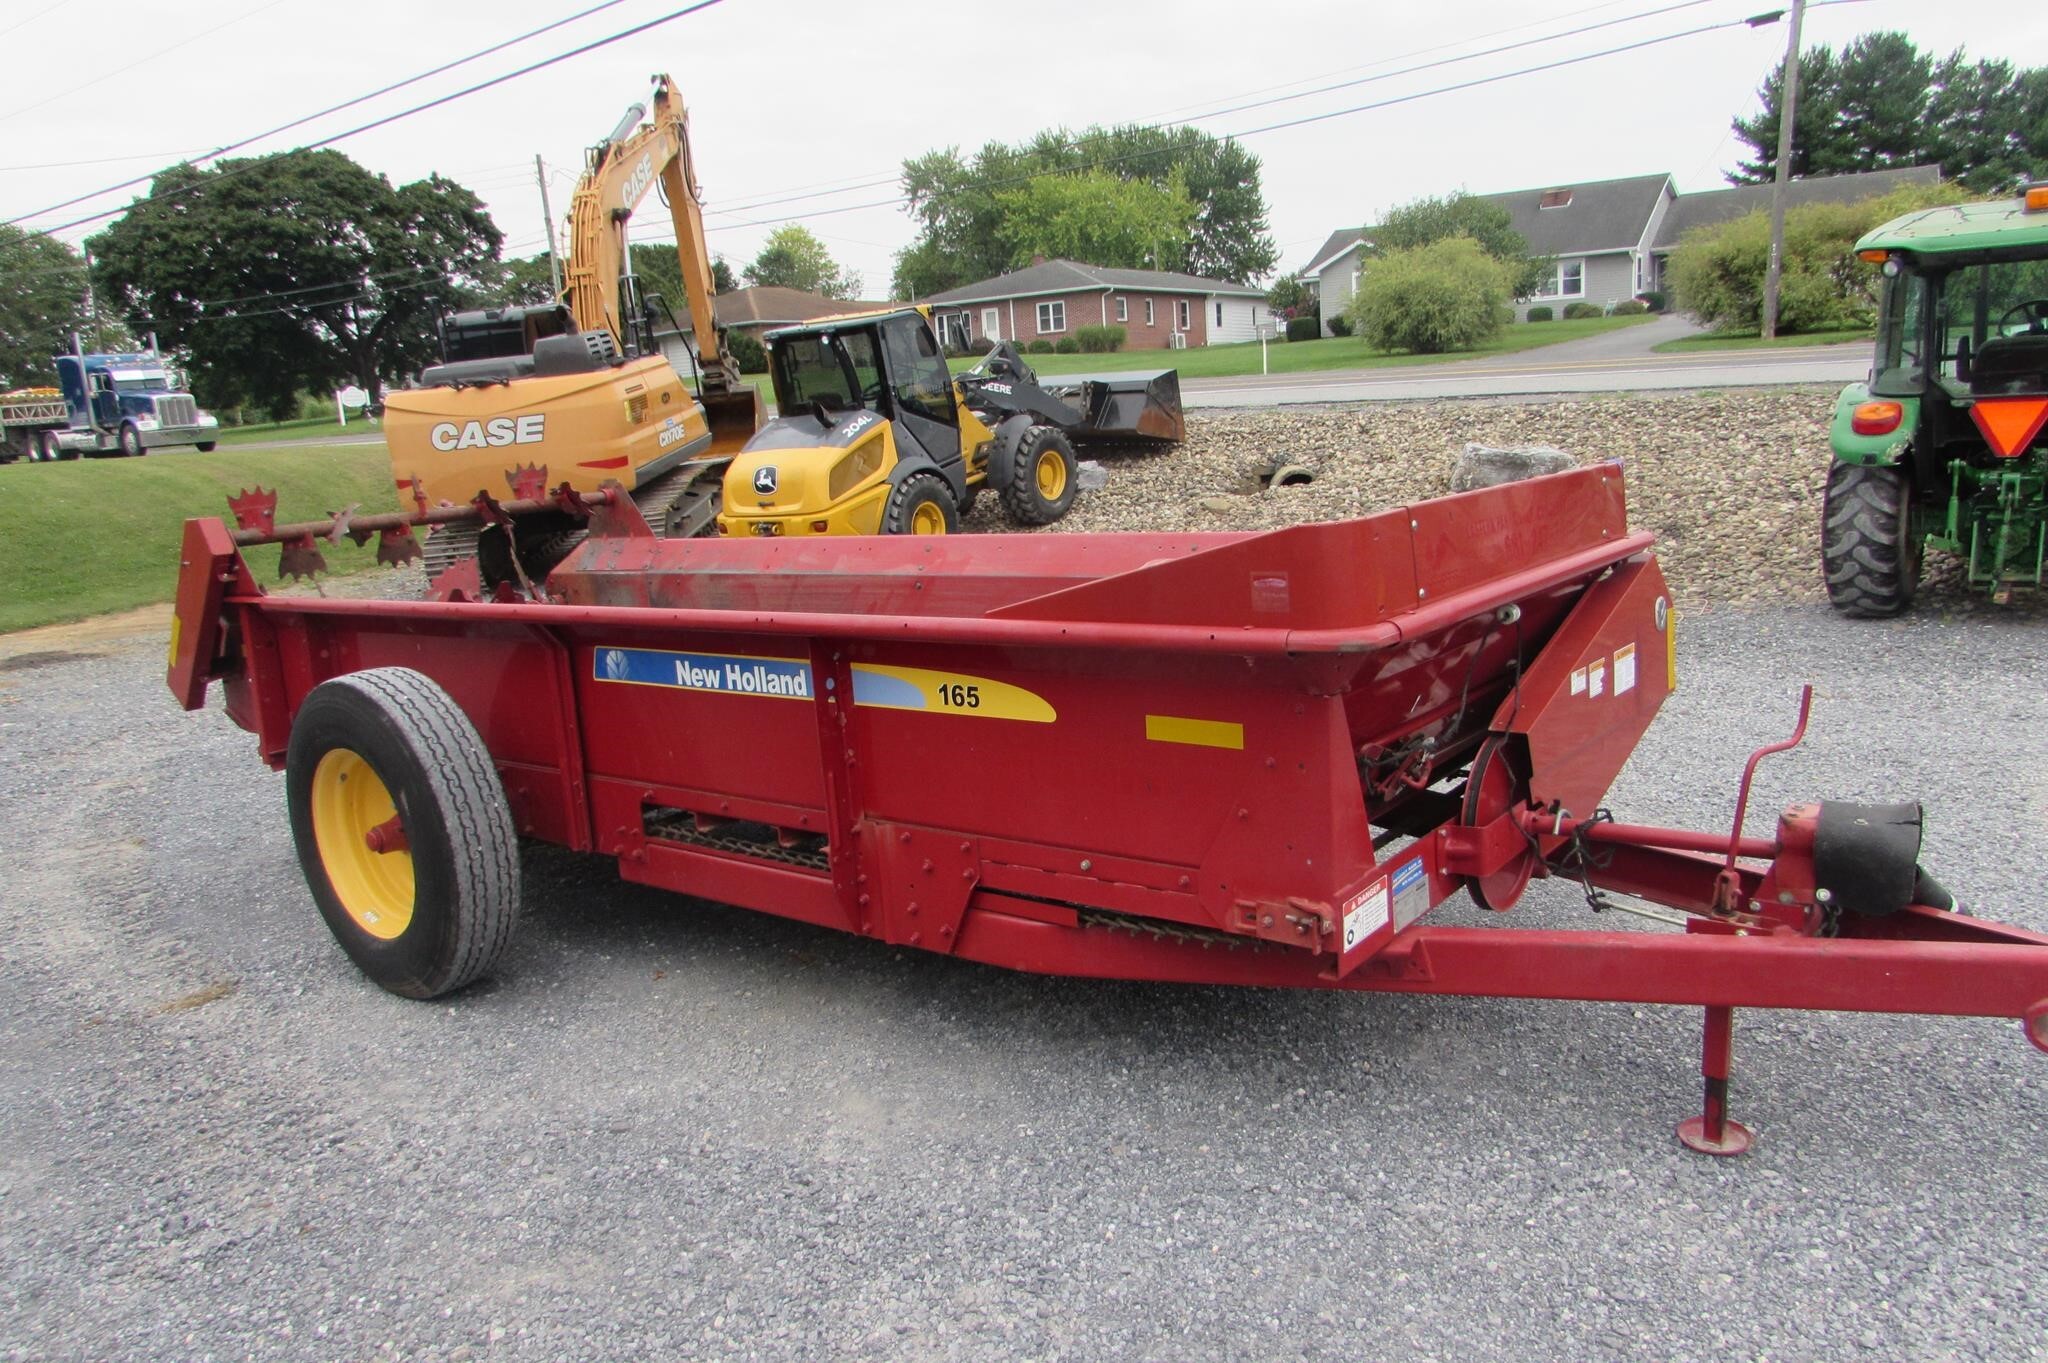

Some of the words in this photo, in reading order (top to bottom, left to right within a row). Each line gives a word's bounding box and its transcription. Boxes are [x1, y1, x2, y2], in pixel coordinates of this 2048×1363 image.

[622, 151, 653, 209] CASE
[431, 414, 545, 451] CASE
[842, 415, 873, 438] 204L
[675, 660, 720, 689] New
[725, 664, 807, 696] Holland
[938, 683, 980, 708] 165
[1357, 883, 1381, 905] DANGER
